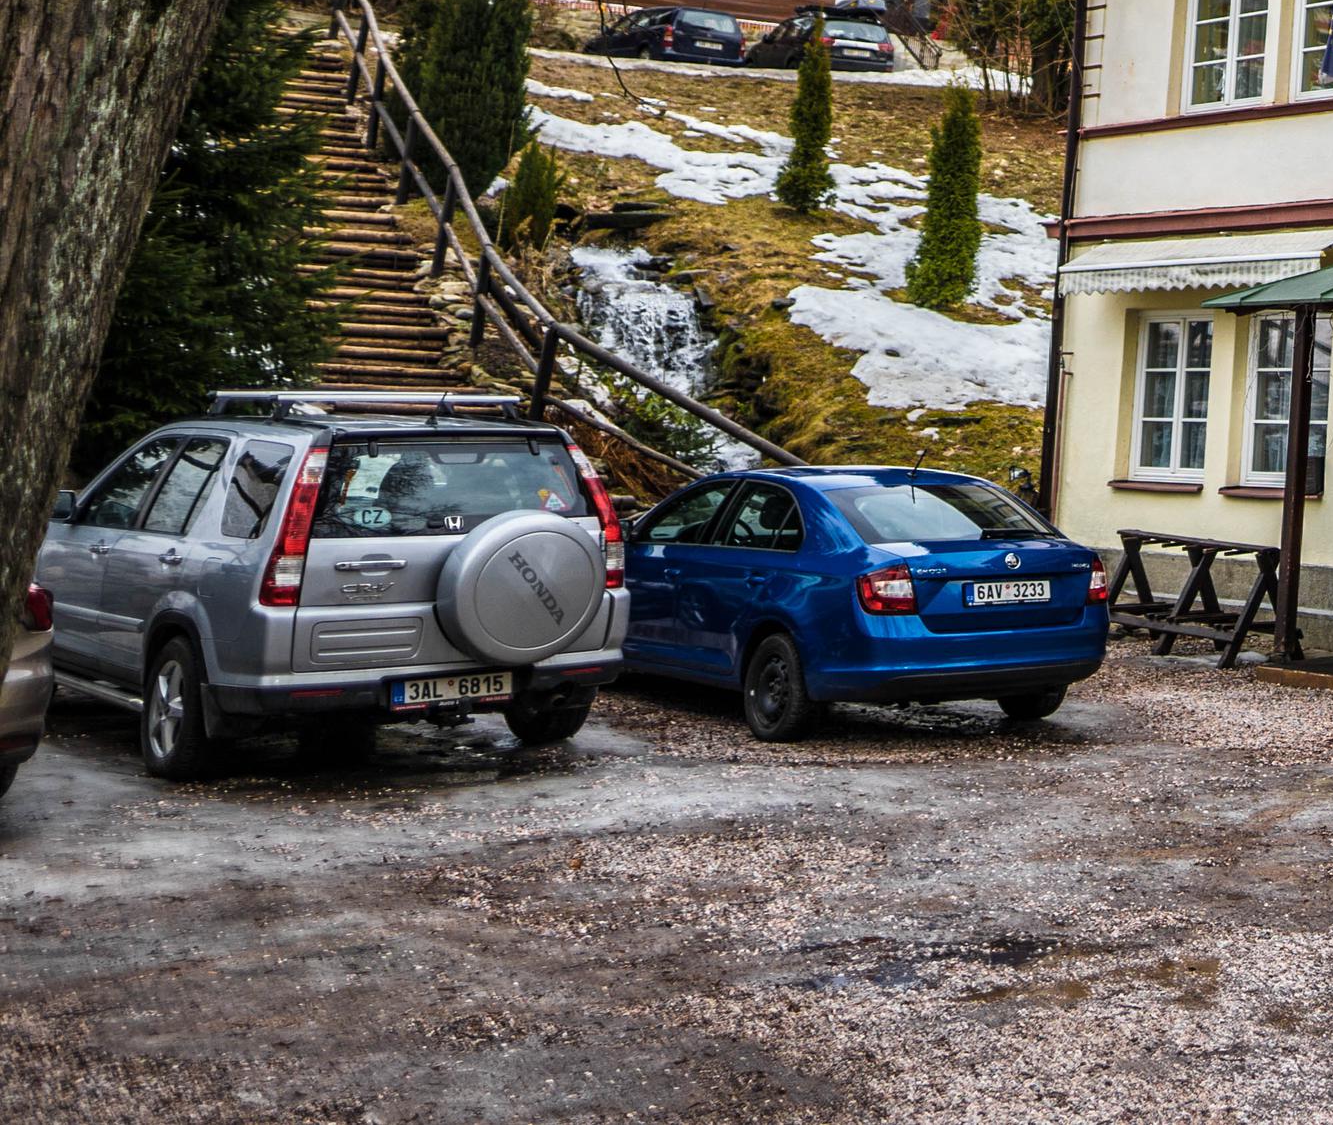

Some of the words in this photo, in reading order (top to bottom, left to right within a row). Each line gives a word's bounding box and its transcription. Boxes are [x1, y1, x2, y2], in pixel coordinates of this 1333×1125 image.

[361, 509, 384, 525] CZ
[508, 550, 566, 626] HONDA
[977, 584, 1003, 600] 6AV
[1013, 582, 1045, 599] 3233
[409, 680, 444, 701] 3AL
[458, 674, 504, 696] 6815
